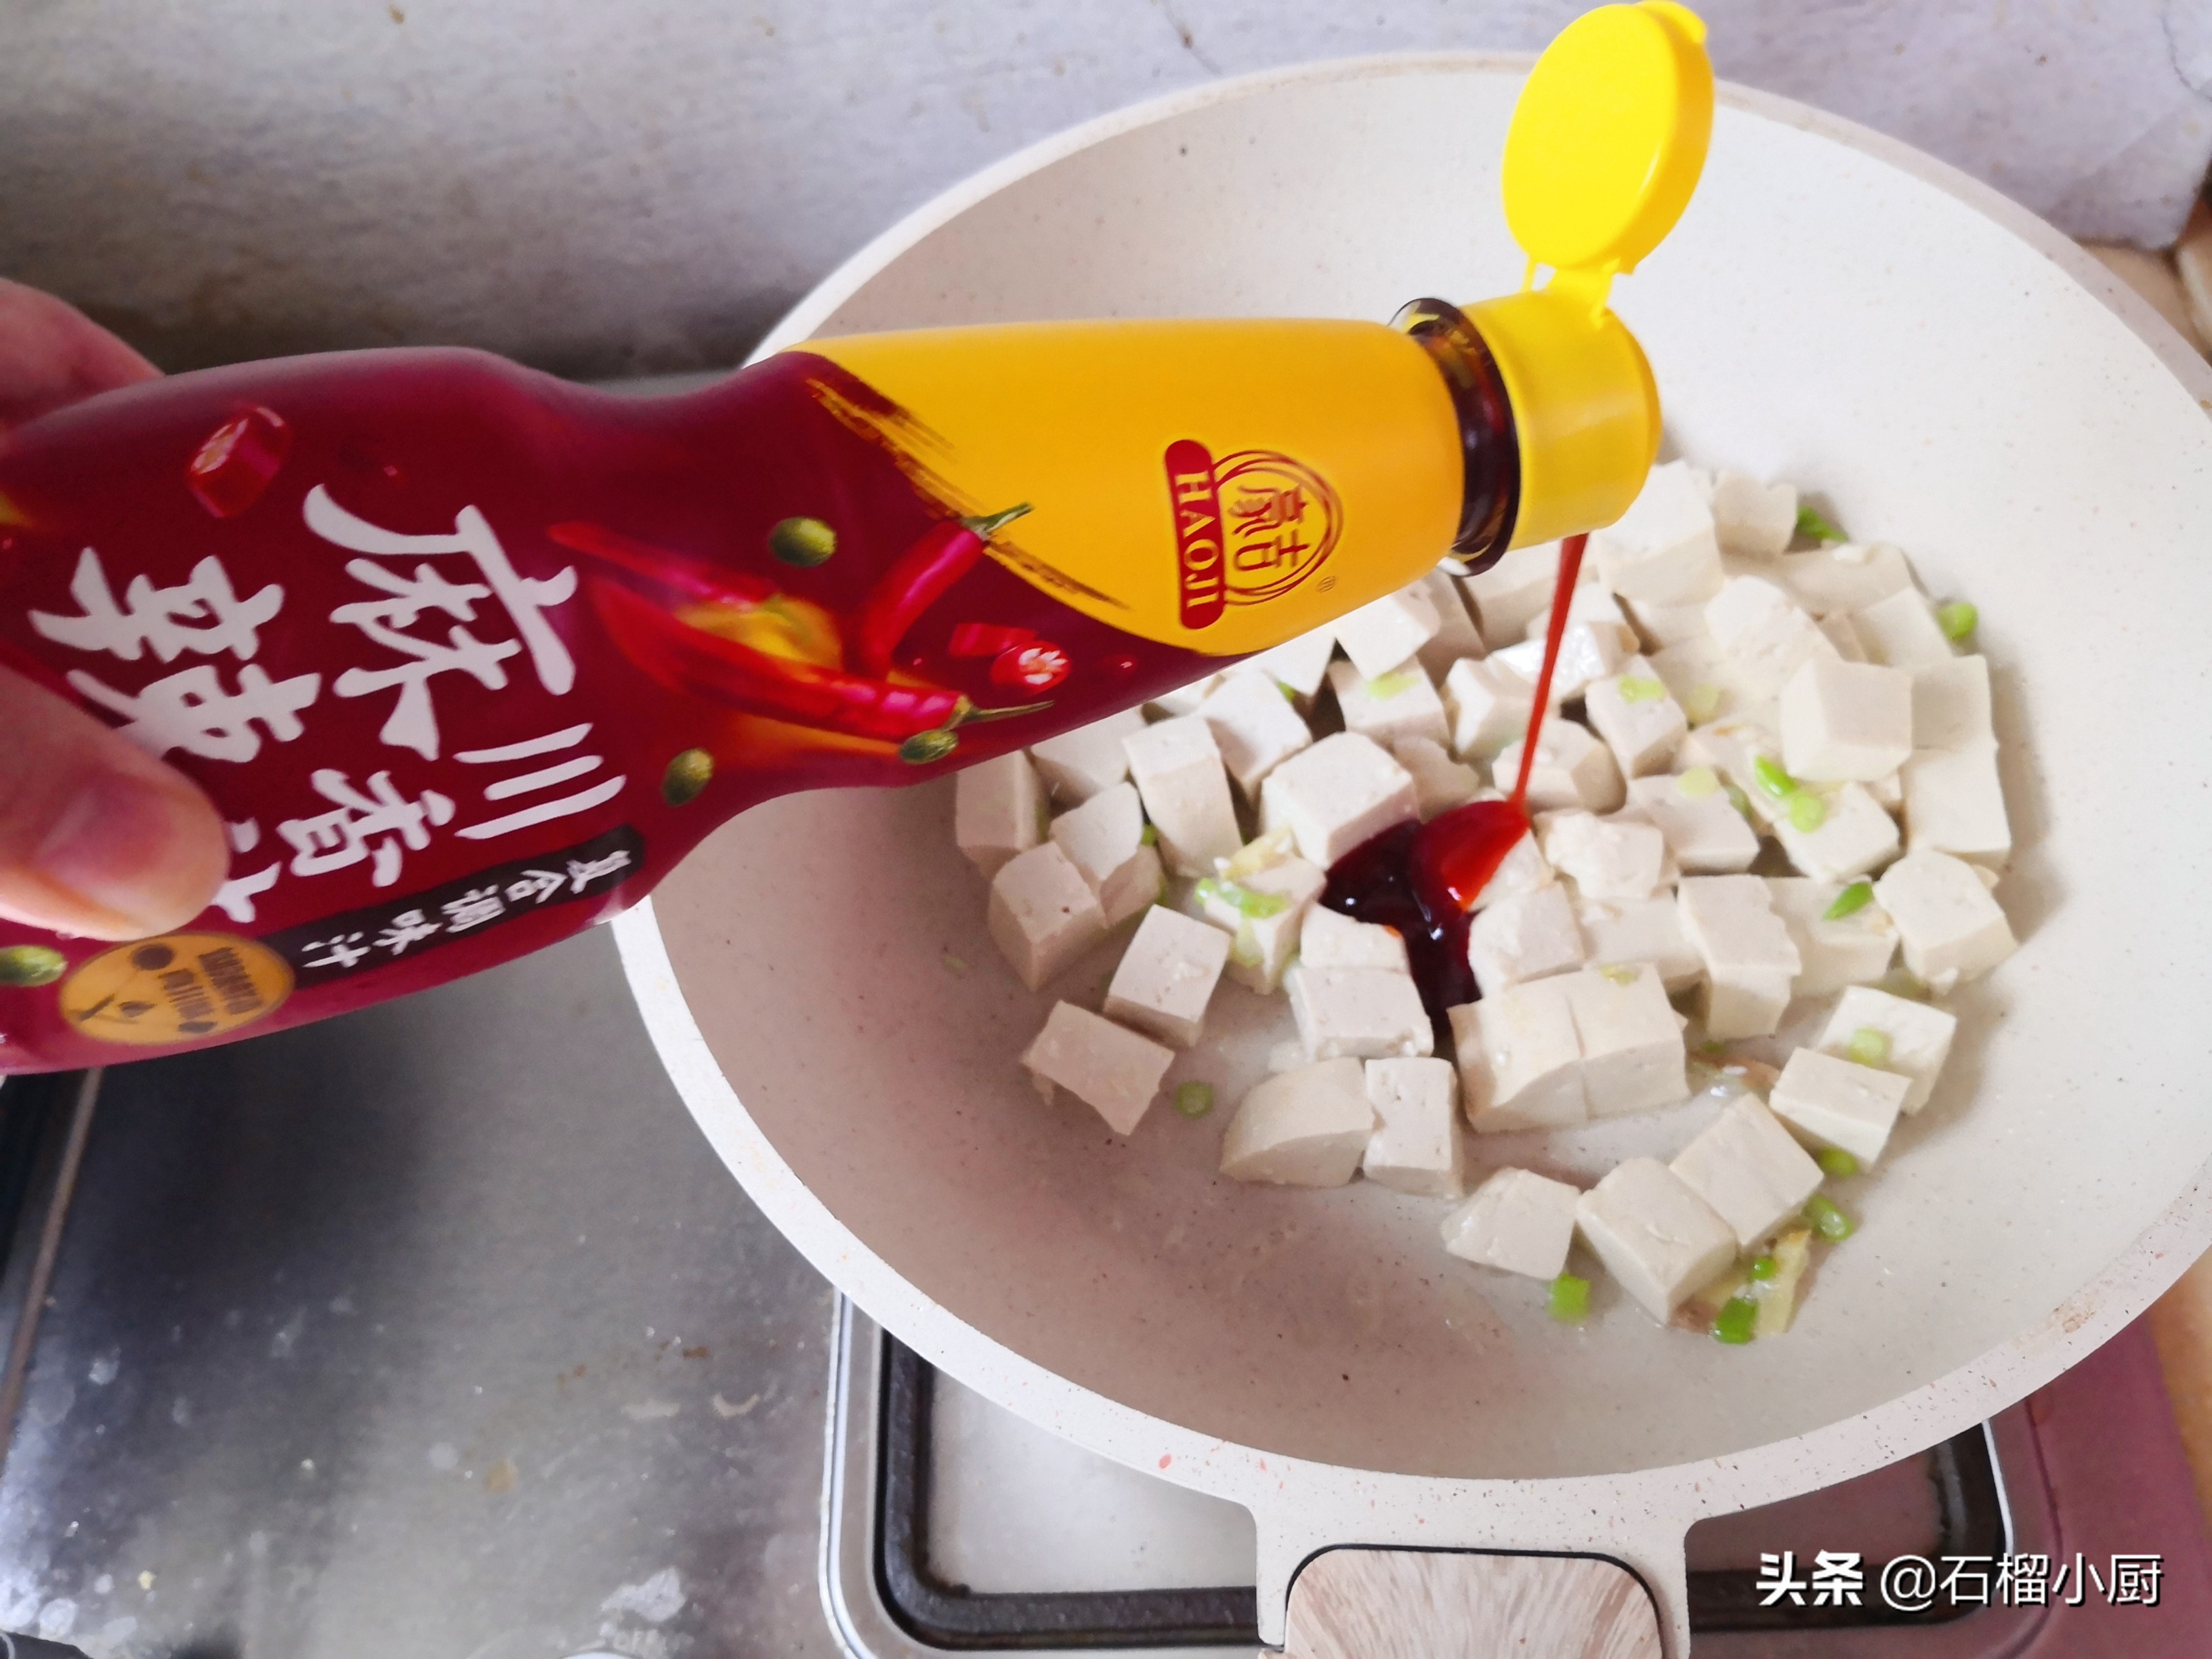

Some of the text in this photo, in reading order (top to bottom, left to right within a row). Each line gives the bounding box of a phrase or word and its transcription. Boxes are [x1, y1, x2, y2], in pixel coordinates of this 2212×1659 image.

[1174, 471, 1219, 610] HAOJI
[301, 849, 631, 968] 复合调味汁
